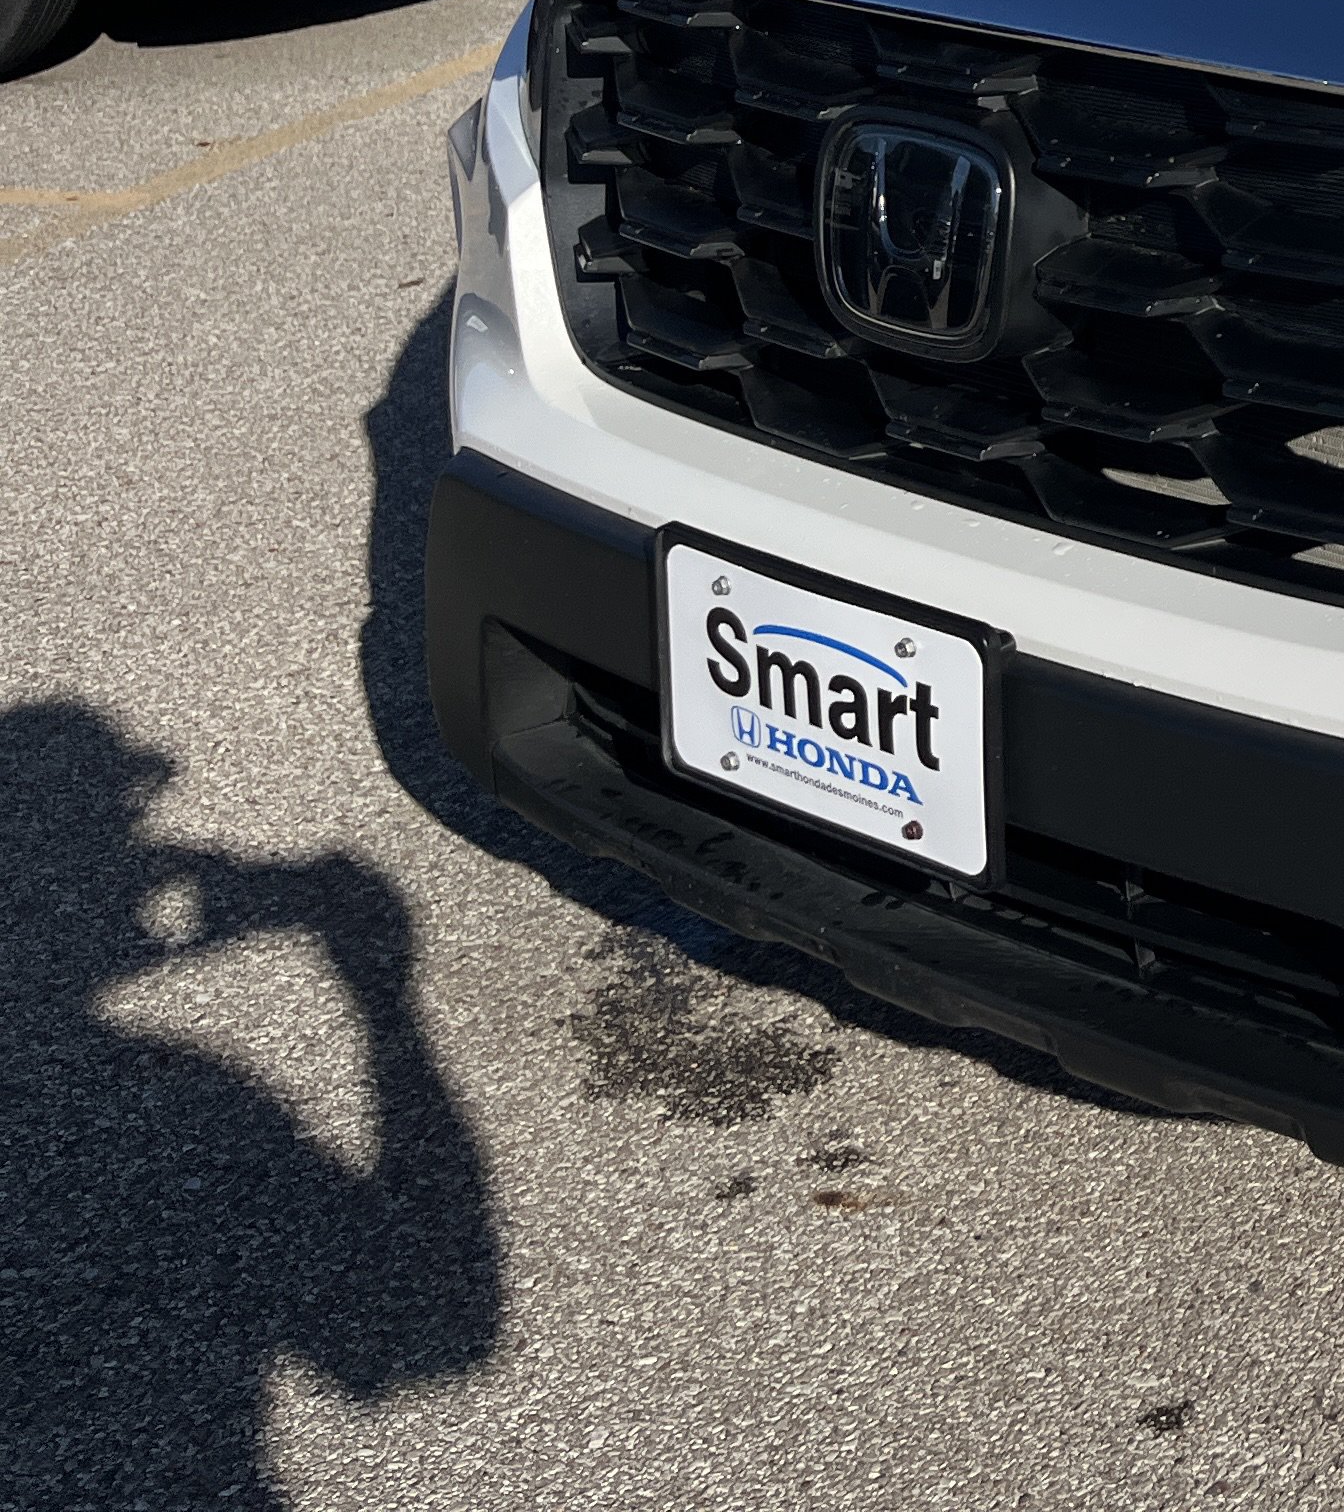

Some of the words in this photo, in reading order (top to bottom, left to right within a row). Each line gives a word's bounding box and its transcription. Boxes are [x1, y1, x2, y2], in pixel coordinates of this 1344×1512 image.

[705, 606, 940, 772] Smart
[746, 752, 904, 819] www.smarthondadesmoines.com
[766, 723, 924, 806] HONDA
